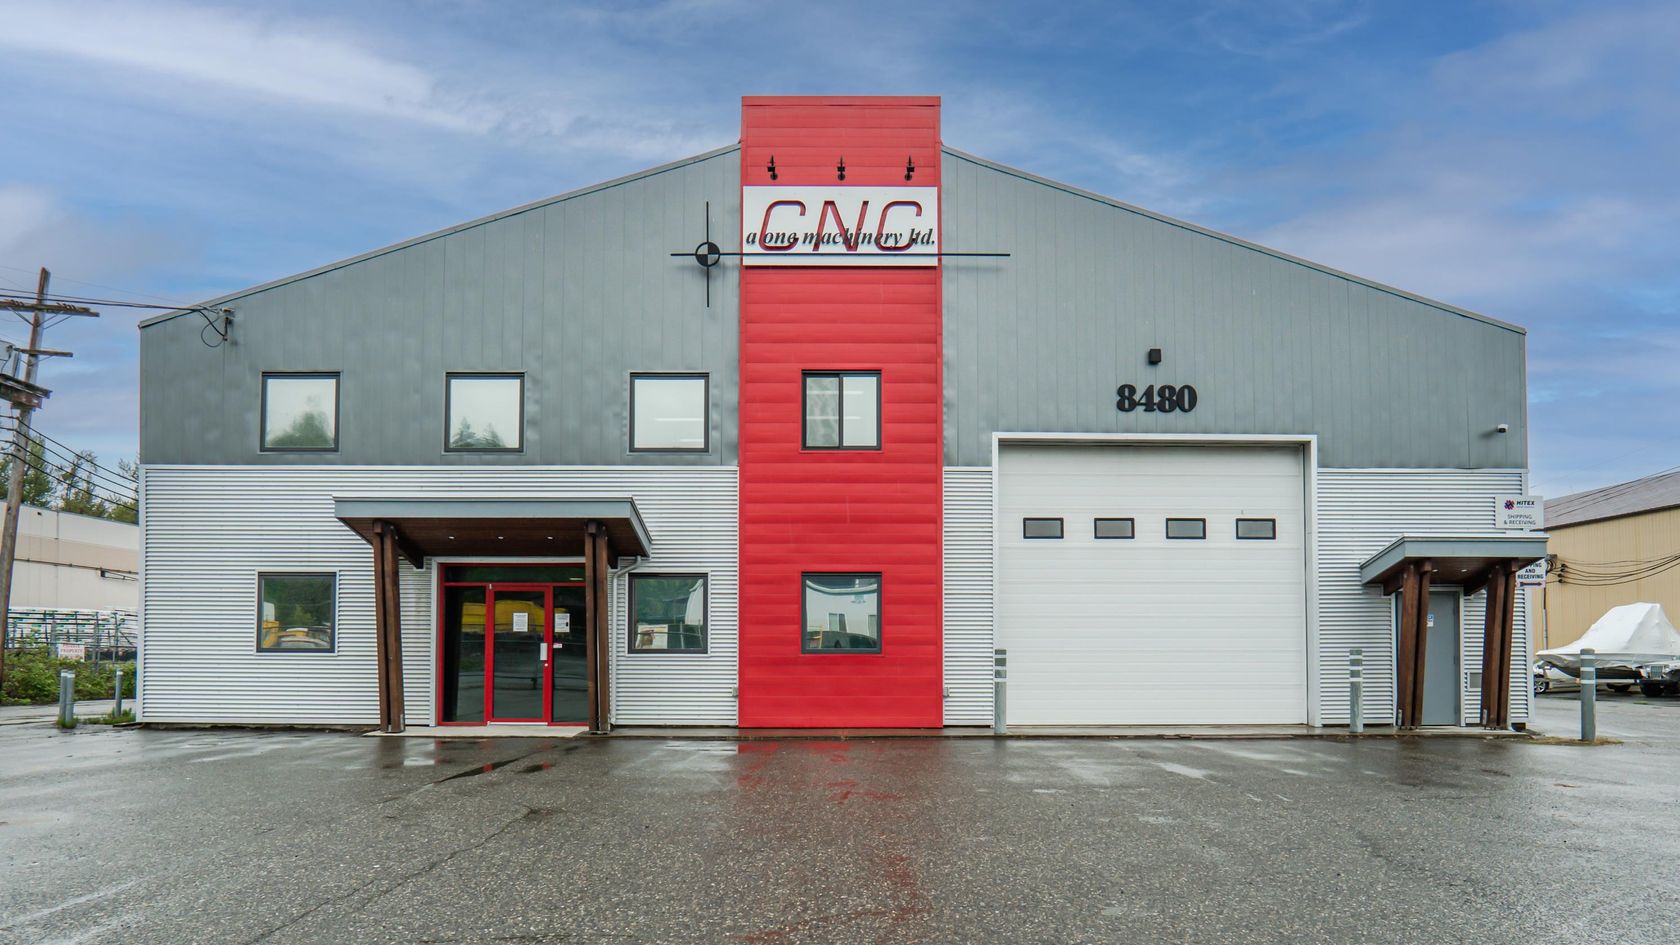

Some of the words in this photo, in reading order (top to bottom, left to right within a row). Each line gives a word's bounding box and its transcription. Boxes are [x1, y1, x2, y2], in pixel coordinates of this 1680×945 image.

[745, 232, 757, 245] a
[763, 232, 798, 245] one
[802, 228, 903, 247] machinery
[909, 228, 935, 245] ltd.
[758, 200, 923, 252] CNC
[1116, 384, 1198, 413] 8480
